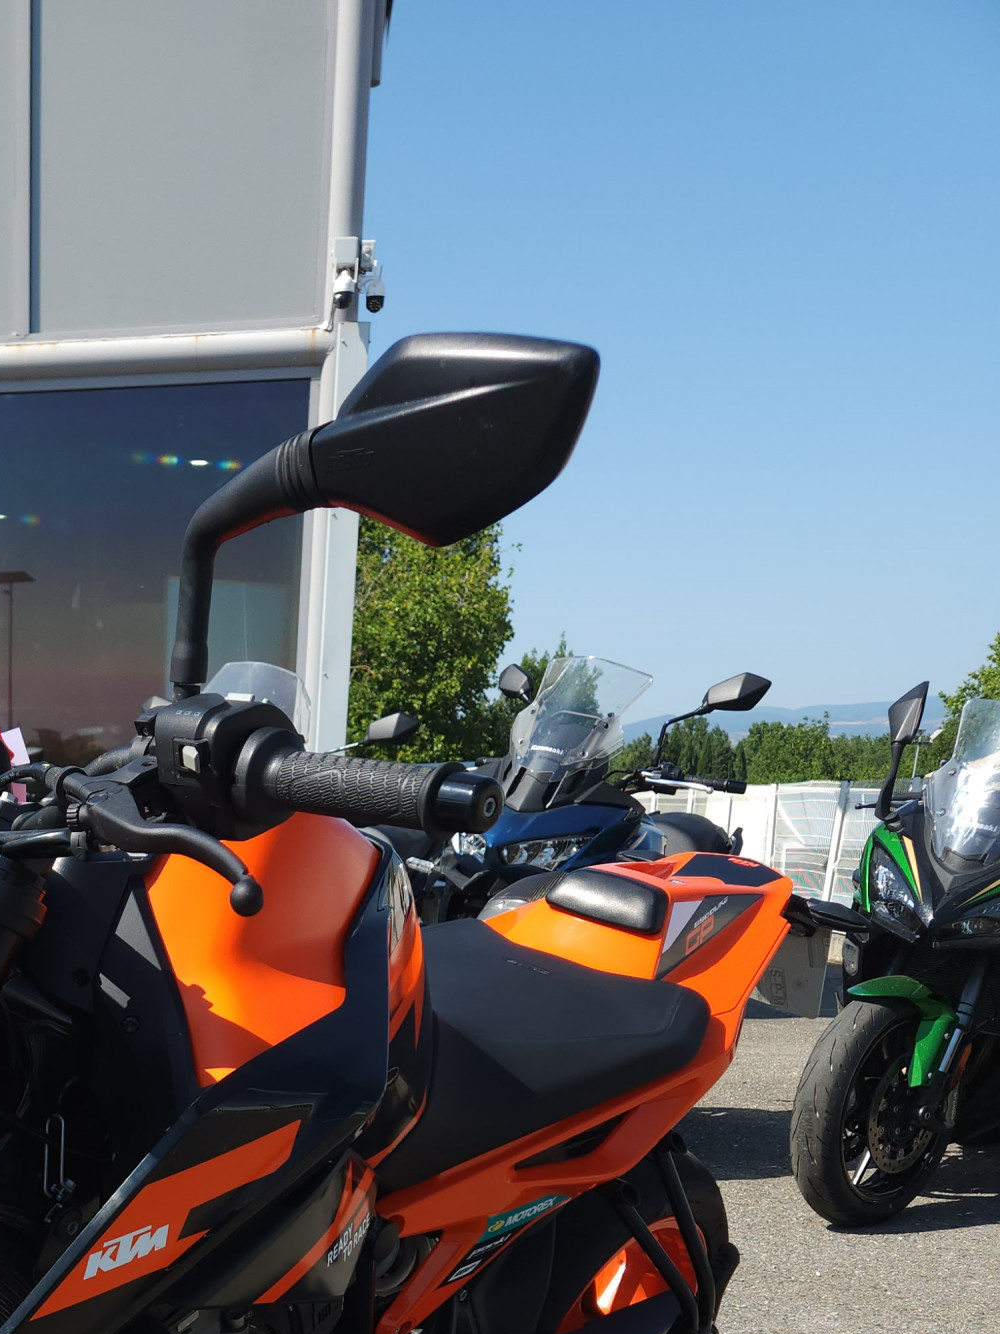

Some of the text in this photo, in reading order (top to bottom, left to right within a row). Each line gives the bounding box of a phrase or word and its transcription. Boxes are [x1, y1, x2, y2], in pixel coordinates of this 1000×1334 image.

[352, 1212, 372, 1250] RACE
[504, 1195, 557, 1228] MOTOREX
[83, 1224, 169, 1280] KTM
[326, 1222, 354, 1268] READY
